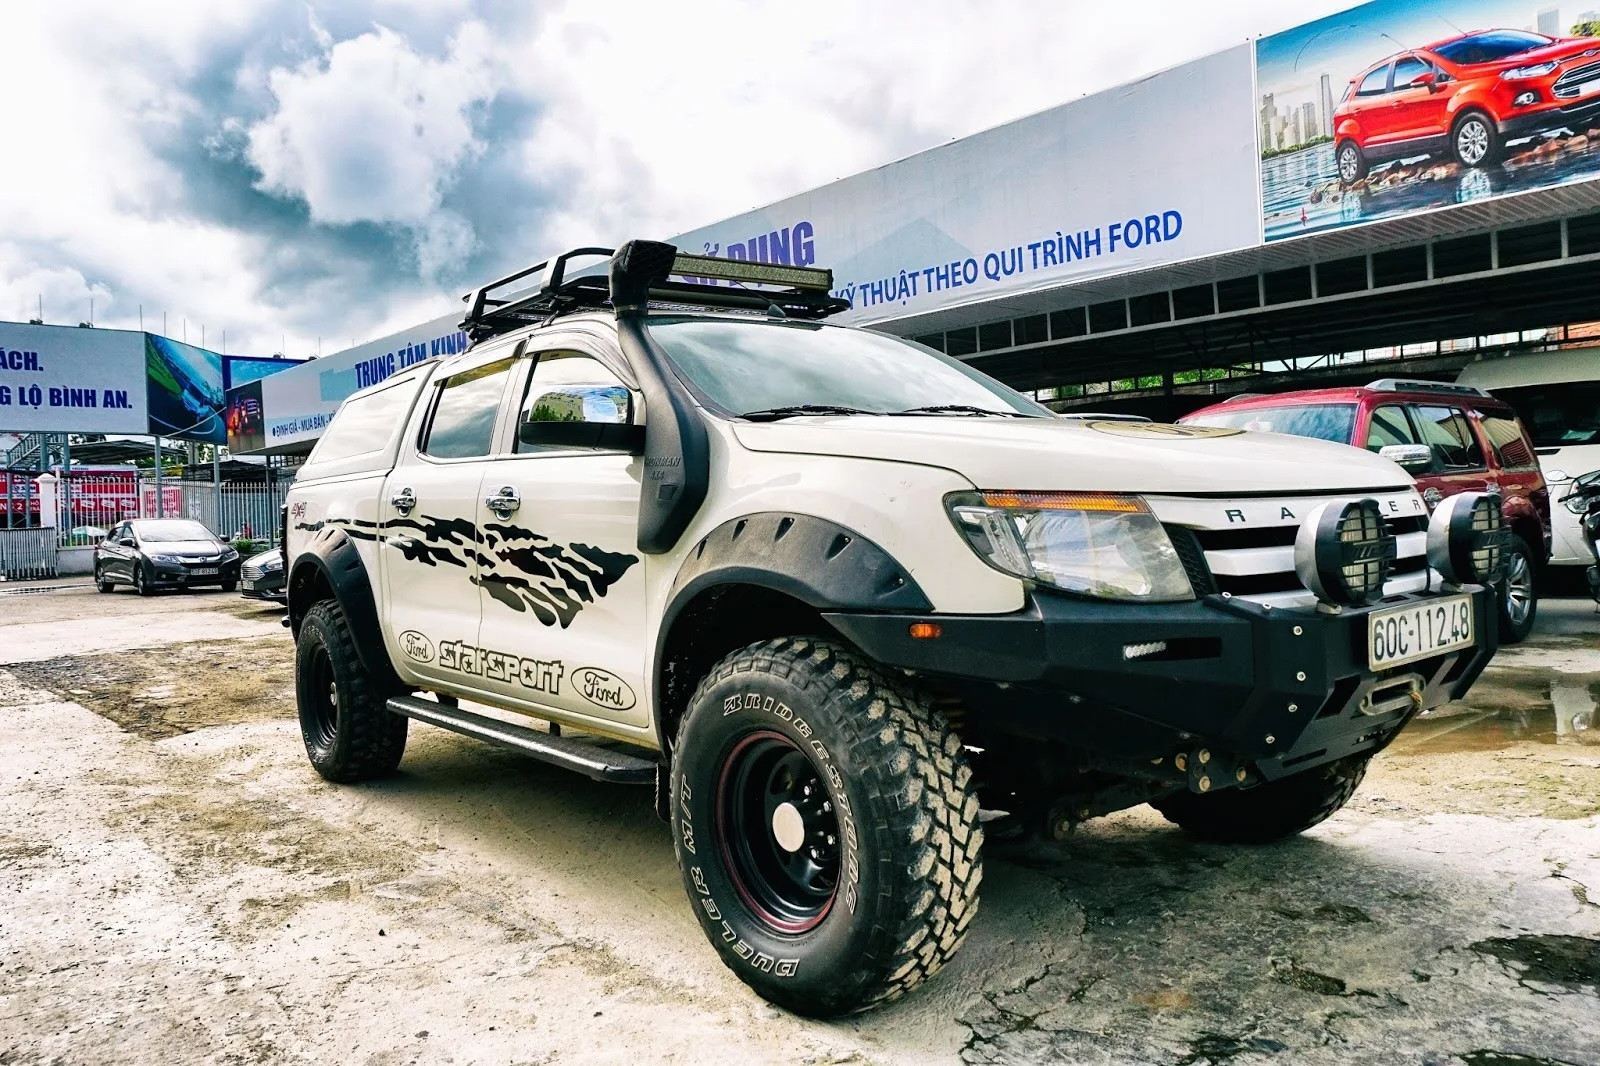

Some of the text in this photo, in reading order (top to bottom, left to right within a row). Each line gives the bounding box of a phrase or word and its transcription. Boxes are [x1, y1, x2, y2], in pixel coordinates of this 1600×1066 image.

[860, 270, 920, 308] THUẬT
[923, 258, 978, 293] THEO
[984, 246, 1024, 281] QUI
[1028, 228, 1101, 269] TRÌNH
[1109, 210, 1183, 253] FORD
[355, 331, 467, 389] TRUNG TÂM KINH
[19, 384, 42, 409] LỘ
[49, 384, 97, 408] BÌNH
[103, 390, 133, 409] AN.
[1225, 499, 1422, 523] RAER
[405, 633, 430, 660] Ford
[583, 671, 624, 707] Ford
[723, 692, 859, 915] BRIDGESTONE
[691, 865, 801, 979] DUELER
